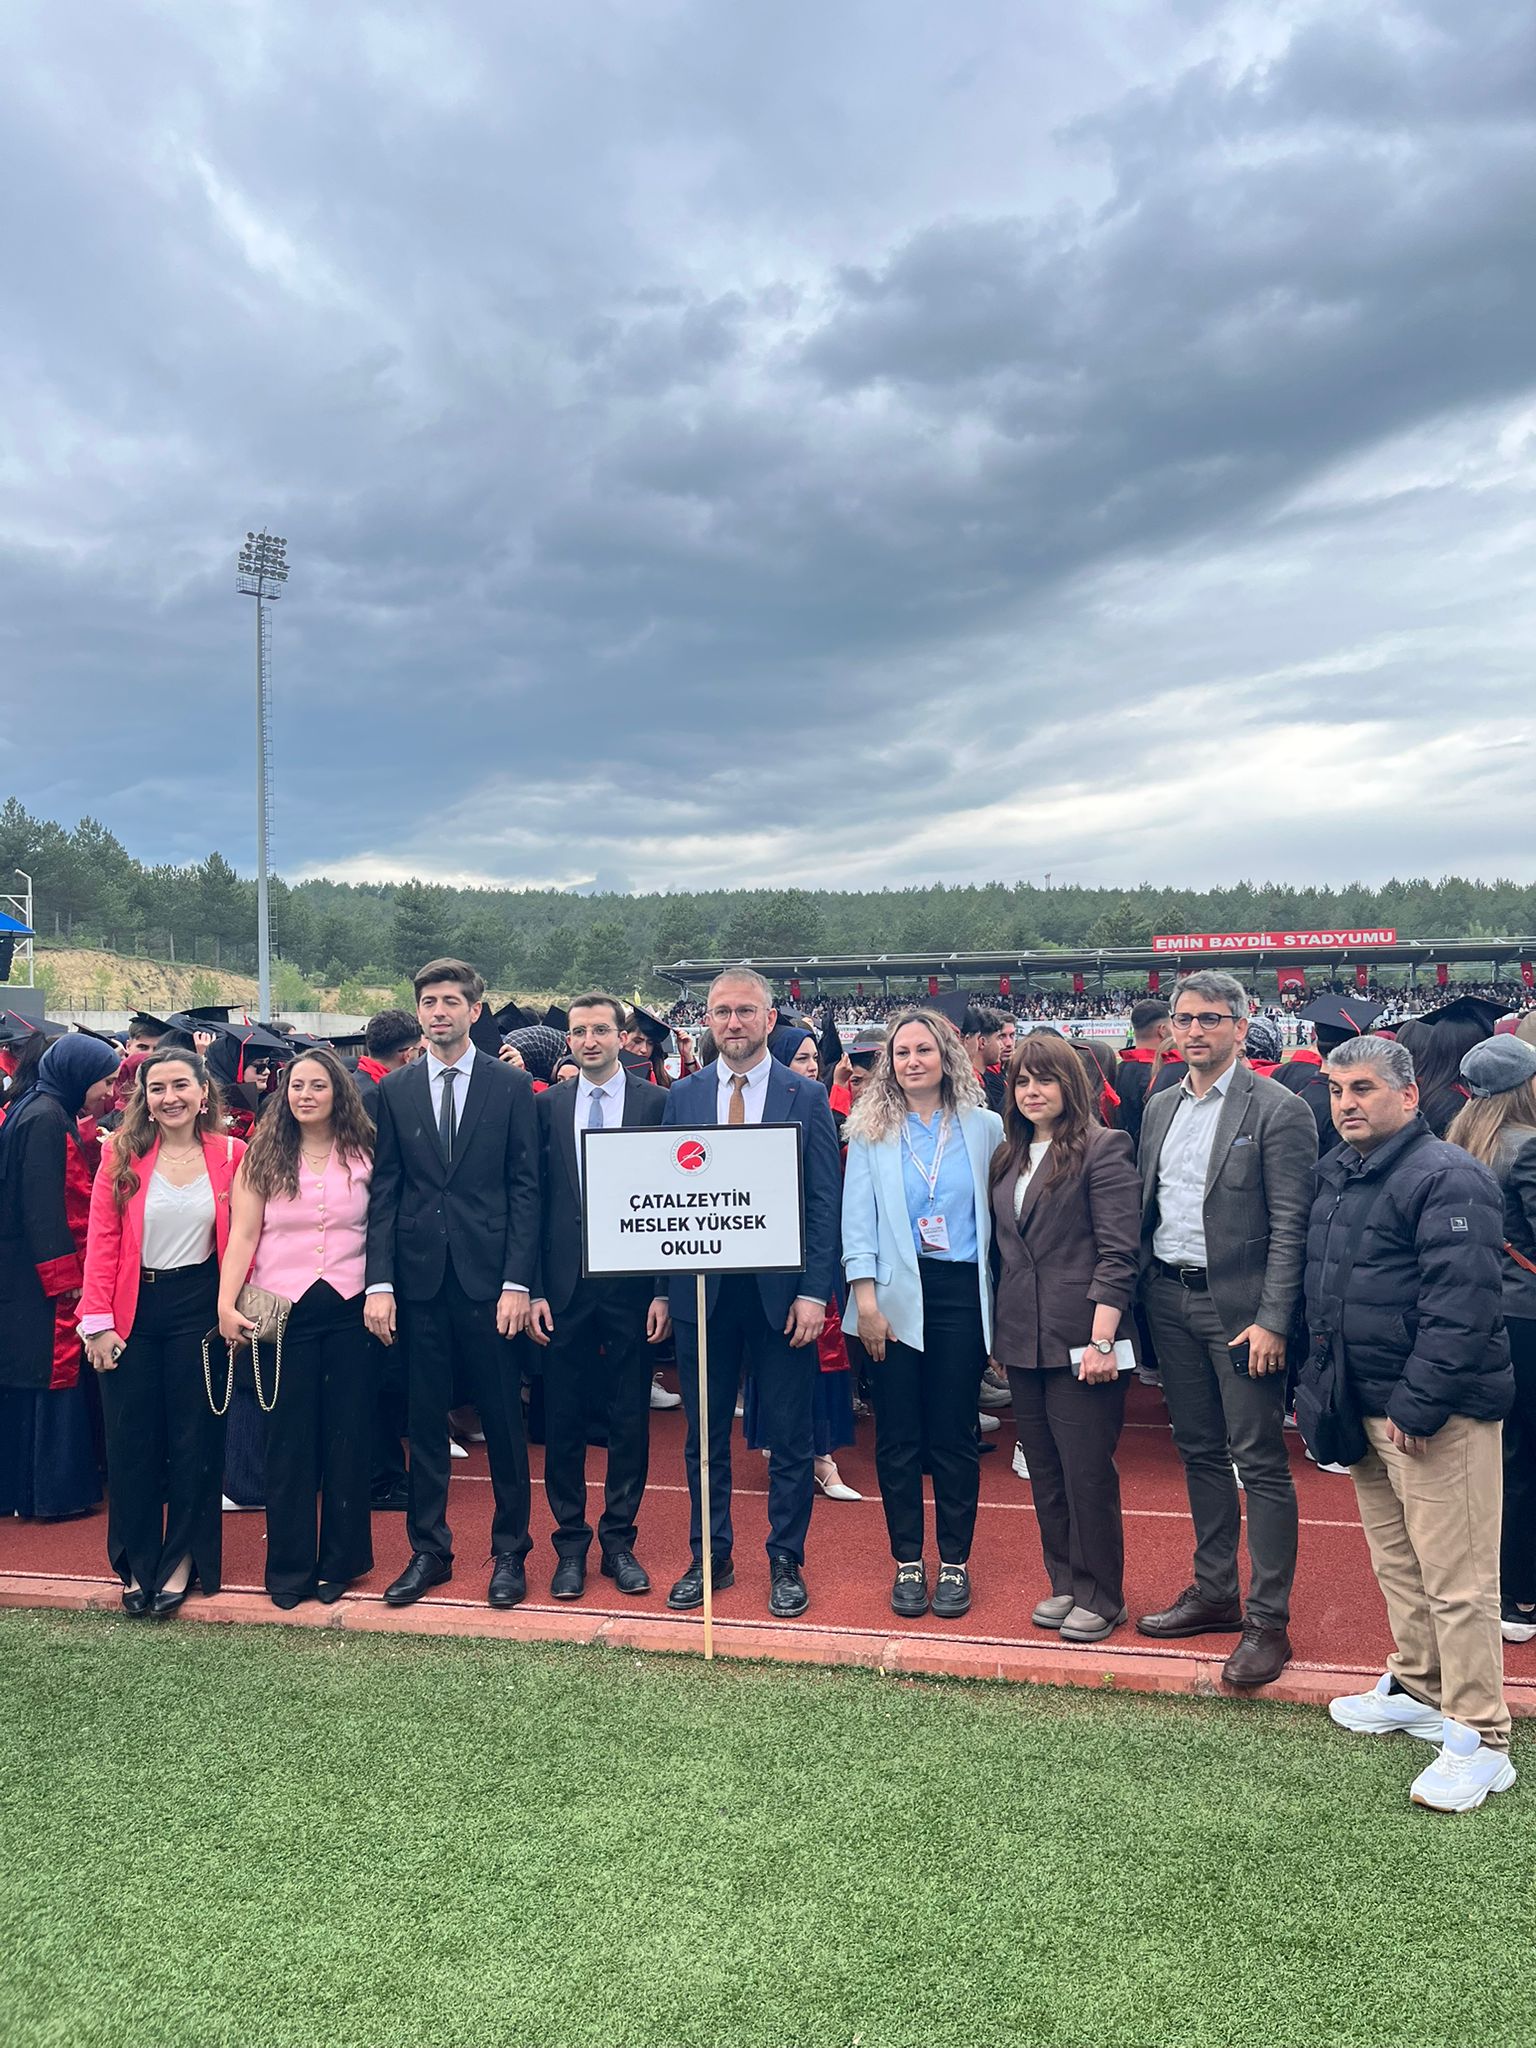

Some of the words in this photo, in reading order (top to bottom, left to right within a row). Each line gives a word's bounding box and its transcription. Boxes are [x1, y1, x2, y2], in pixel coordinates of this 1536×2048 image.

[1156, 935, 1203, 949] EMİN
[1209, 933, 1276, 948] BAYDİL
[1284, 931, 1393, 946] STADYUMU
[629, 1189, 751, 1211] ÇATALZEYTİN
[620, 1217, 690, 1233] MESLEK
[695, 1213, 767, 1231] YÜKSEK
[660, 1240, 722, 1256] OKULU
